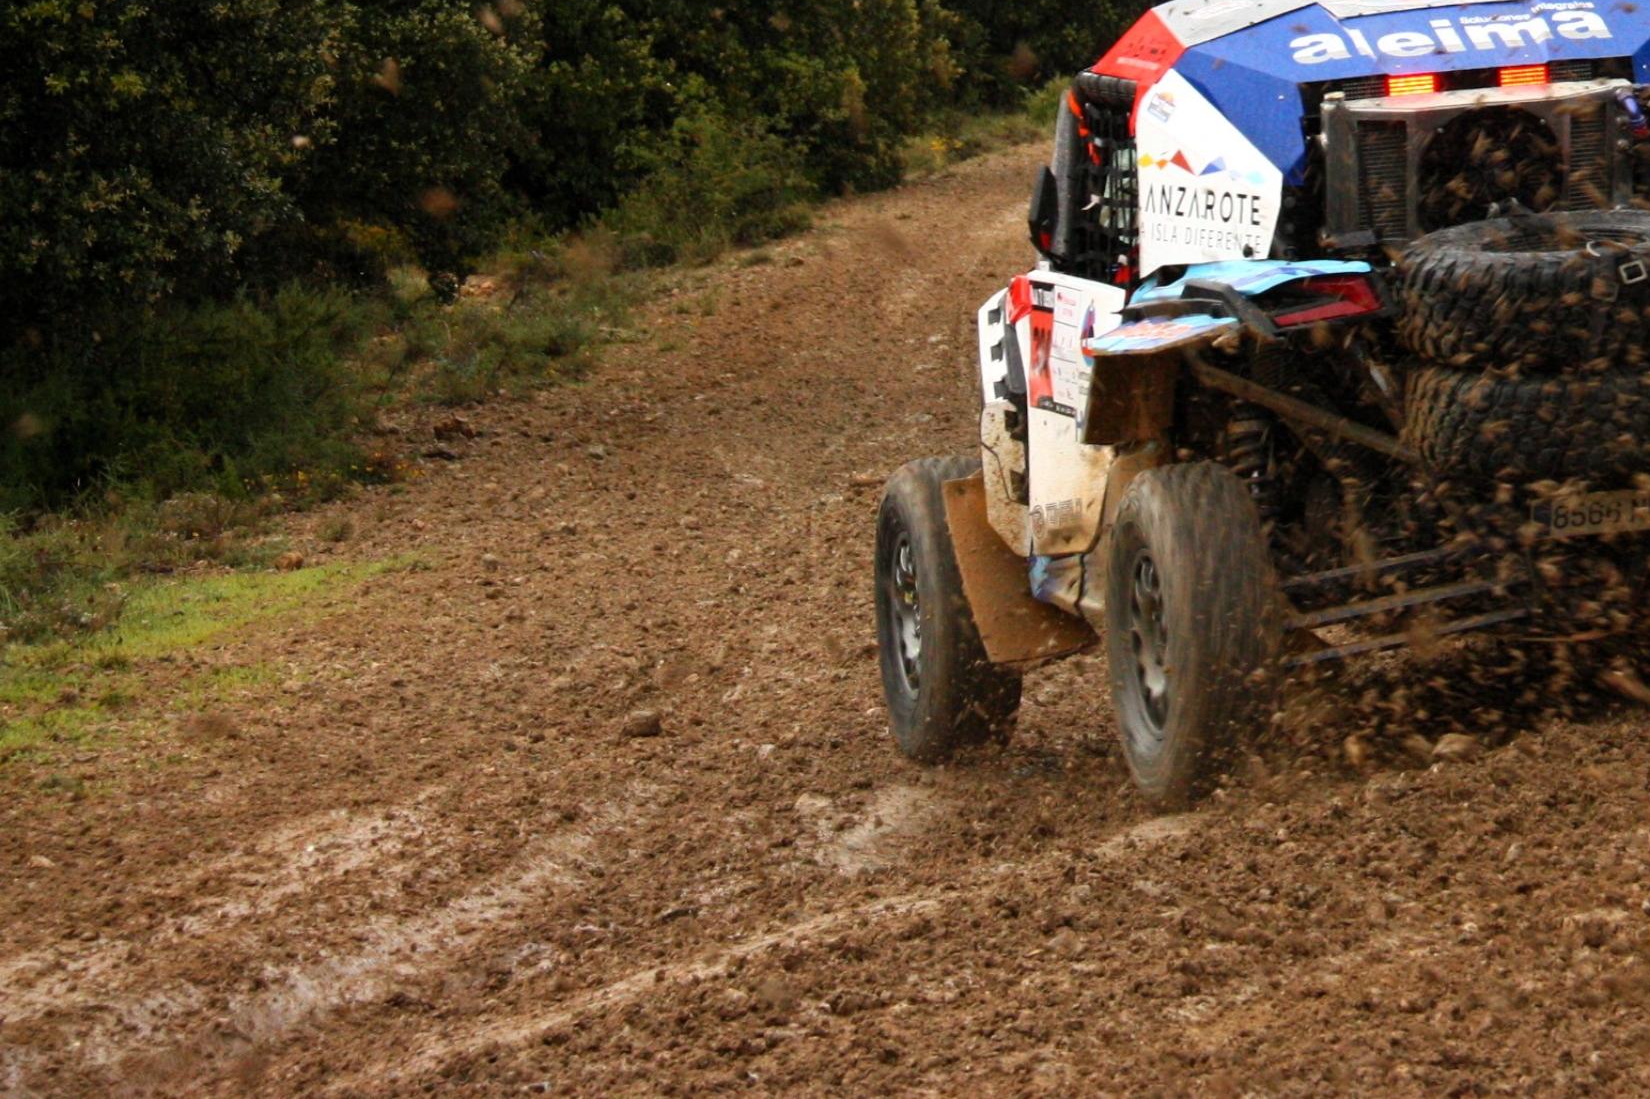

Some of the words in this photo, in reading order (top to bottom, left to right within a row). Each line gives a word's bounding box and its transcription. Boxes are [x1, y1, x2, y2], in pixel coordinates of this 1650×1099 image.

[1289, 10, 1613, 64] aleima
[1459, 13, 1530, 24] Solucones
[1144, 184, 1261, 226] ANZAROTE
[1152, 222, 1178, 246] ISLA
[1184, 226, 1261, 254] DIFERENTE
